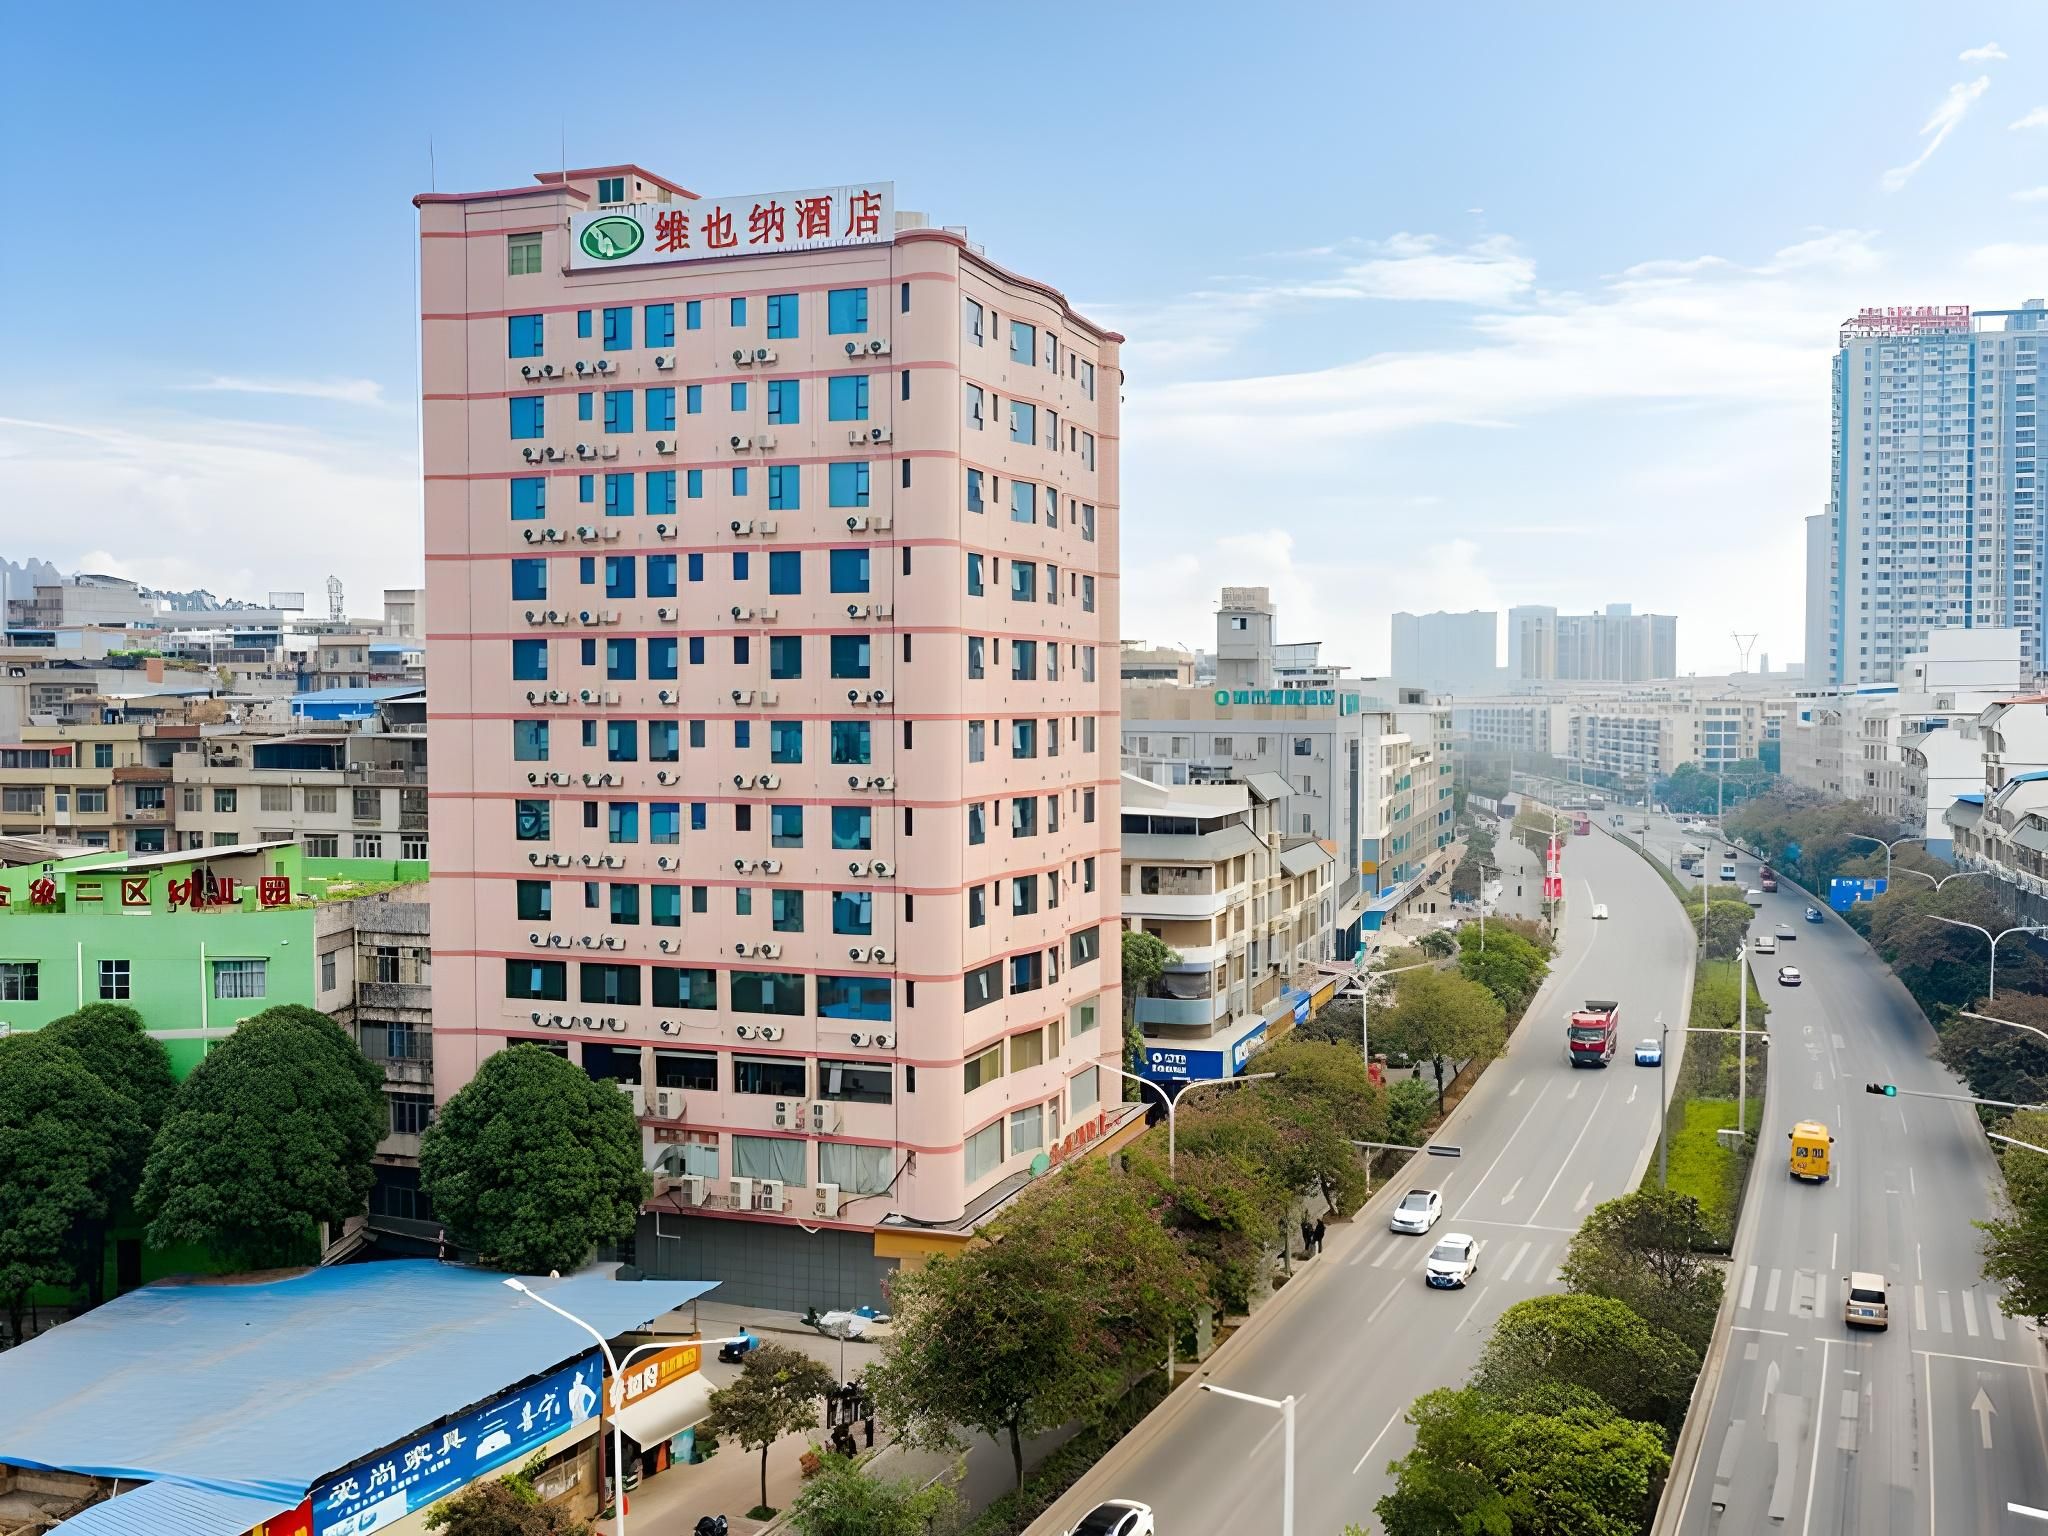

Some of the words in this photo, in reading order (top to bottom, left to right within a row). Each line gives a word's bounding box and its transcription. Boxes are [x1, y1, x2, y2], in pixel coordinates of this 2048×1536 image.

[655, 189, 882, 253] 维也纳酒店
